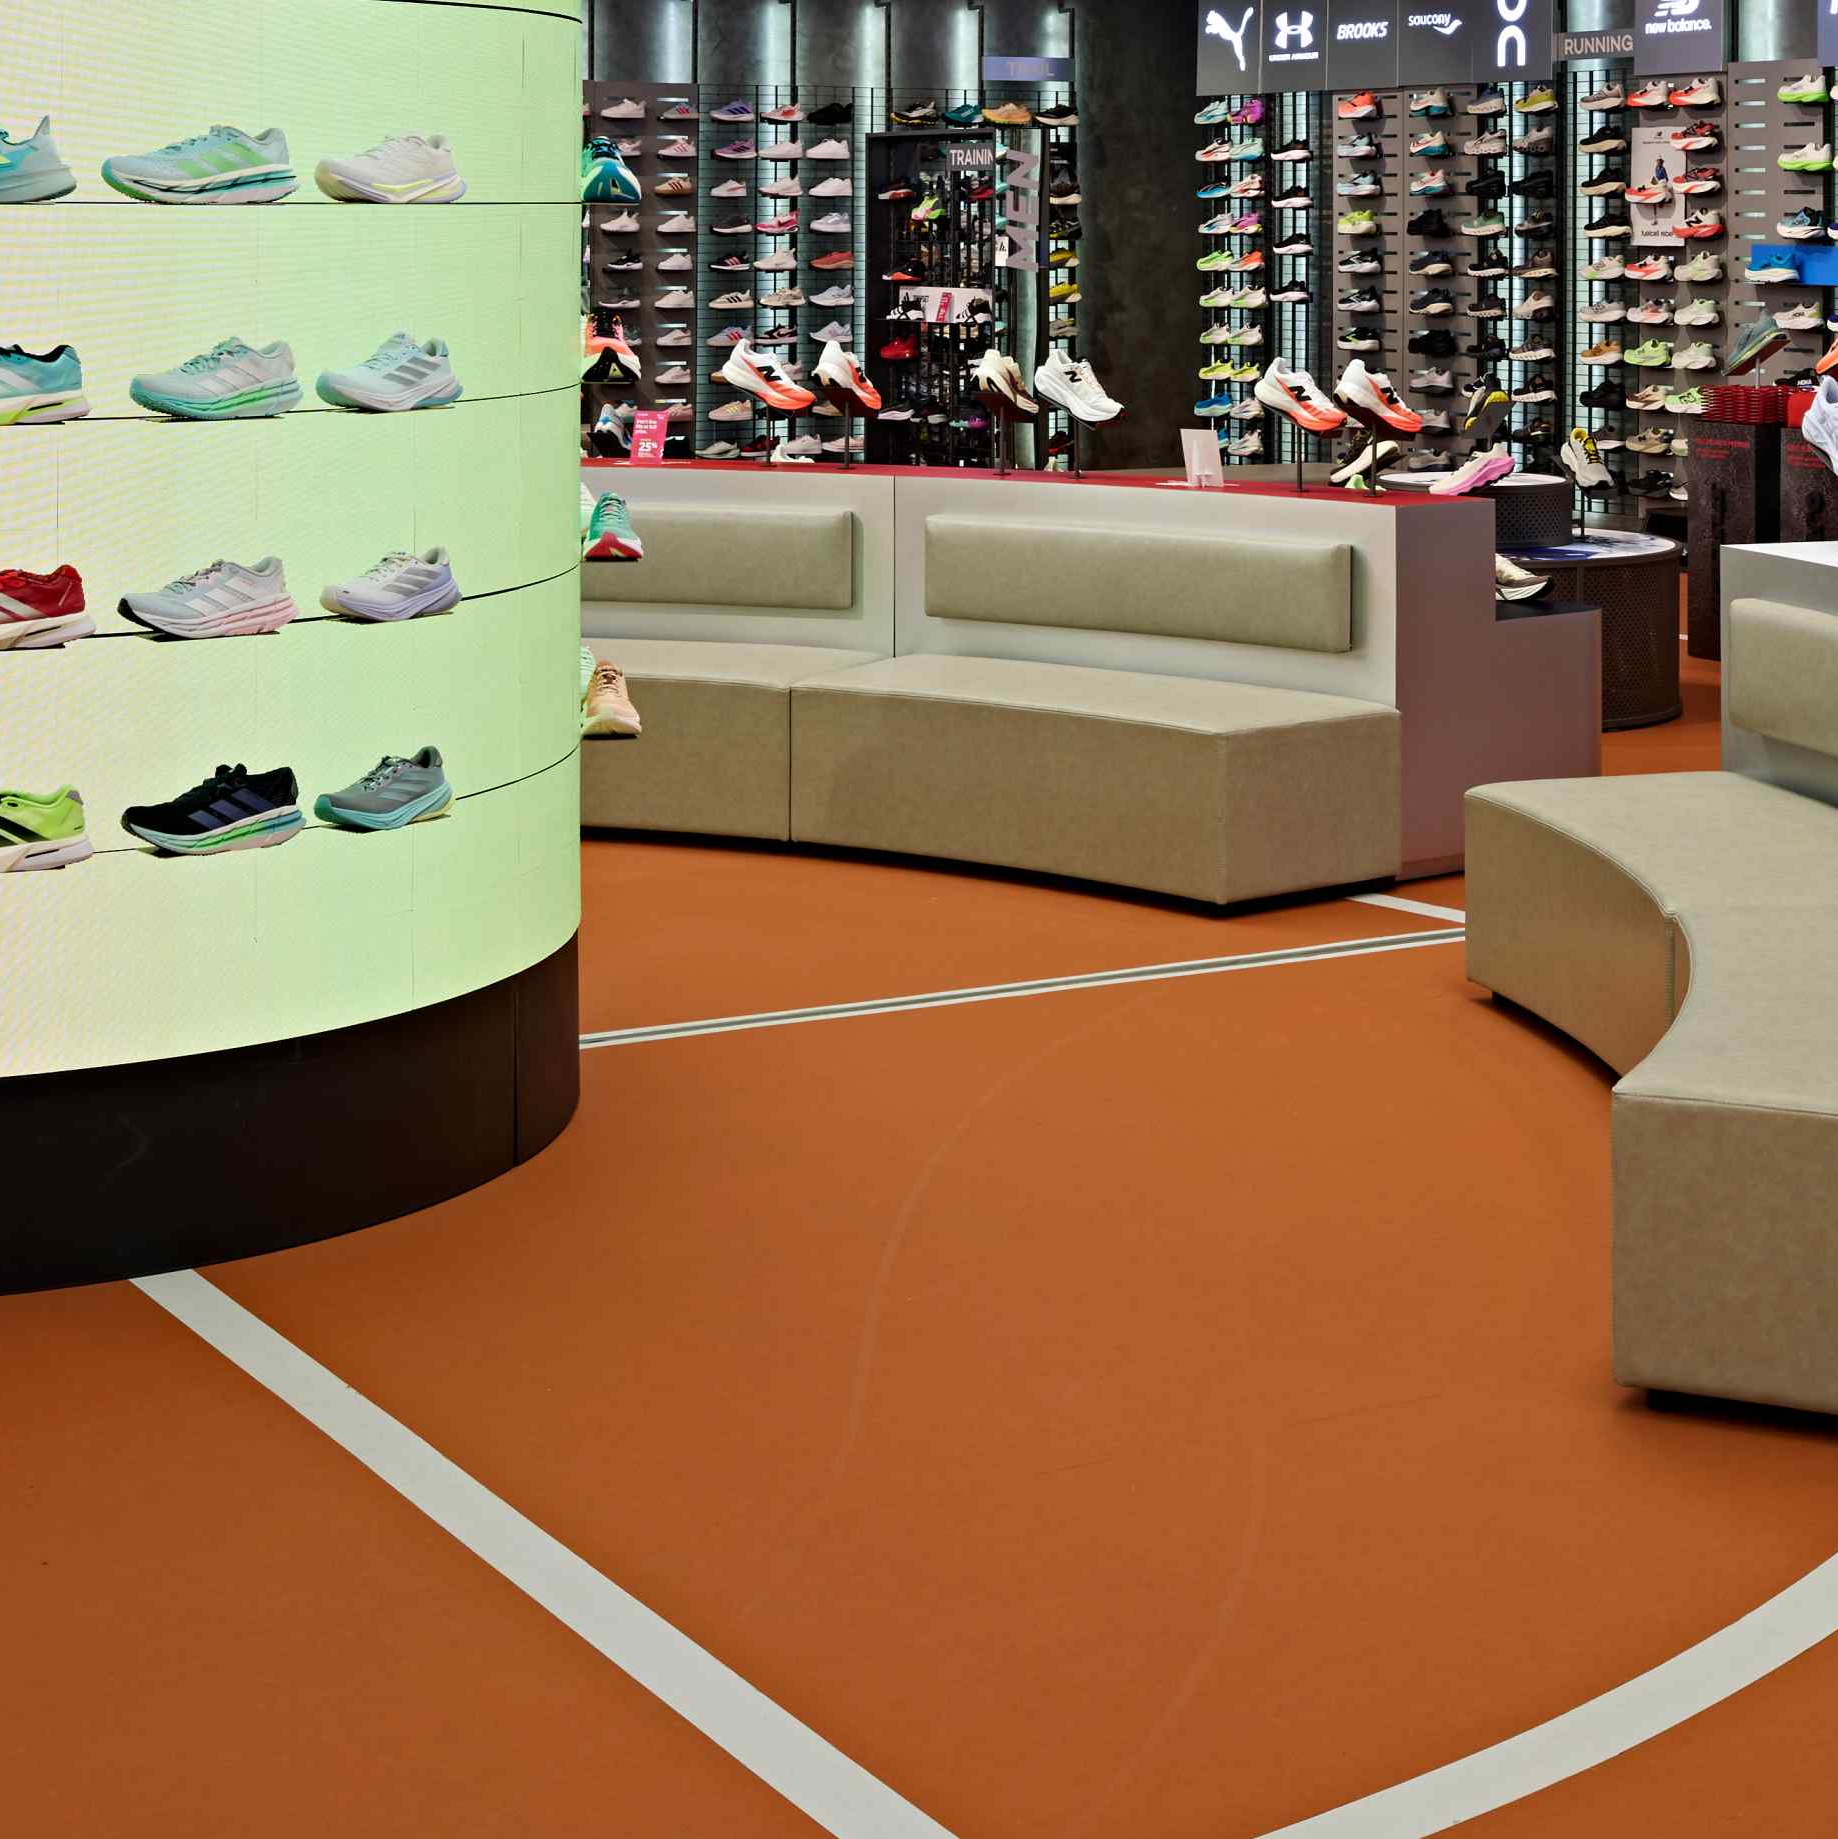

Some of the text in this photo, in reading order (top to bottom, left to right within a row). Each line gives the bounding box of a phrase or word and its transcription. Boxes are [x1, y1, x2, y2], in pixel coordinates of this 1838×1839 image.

[1408, 12, 1451, 28] saucony
[1645, 22, 1666, 34] new
[1336, 22, 1388, 40] BROOKS
[1564, 34, 1633, 56] RUNNING
[949, 149, 993, 166] TRAININ
[1006, 149, 1039, 272] MEN
